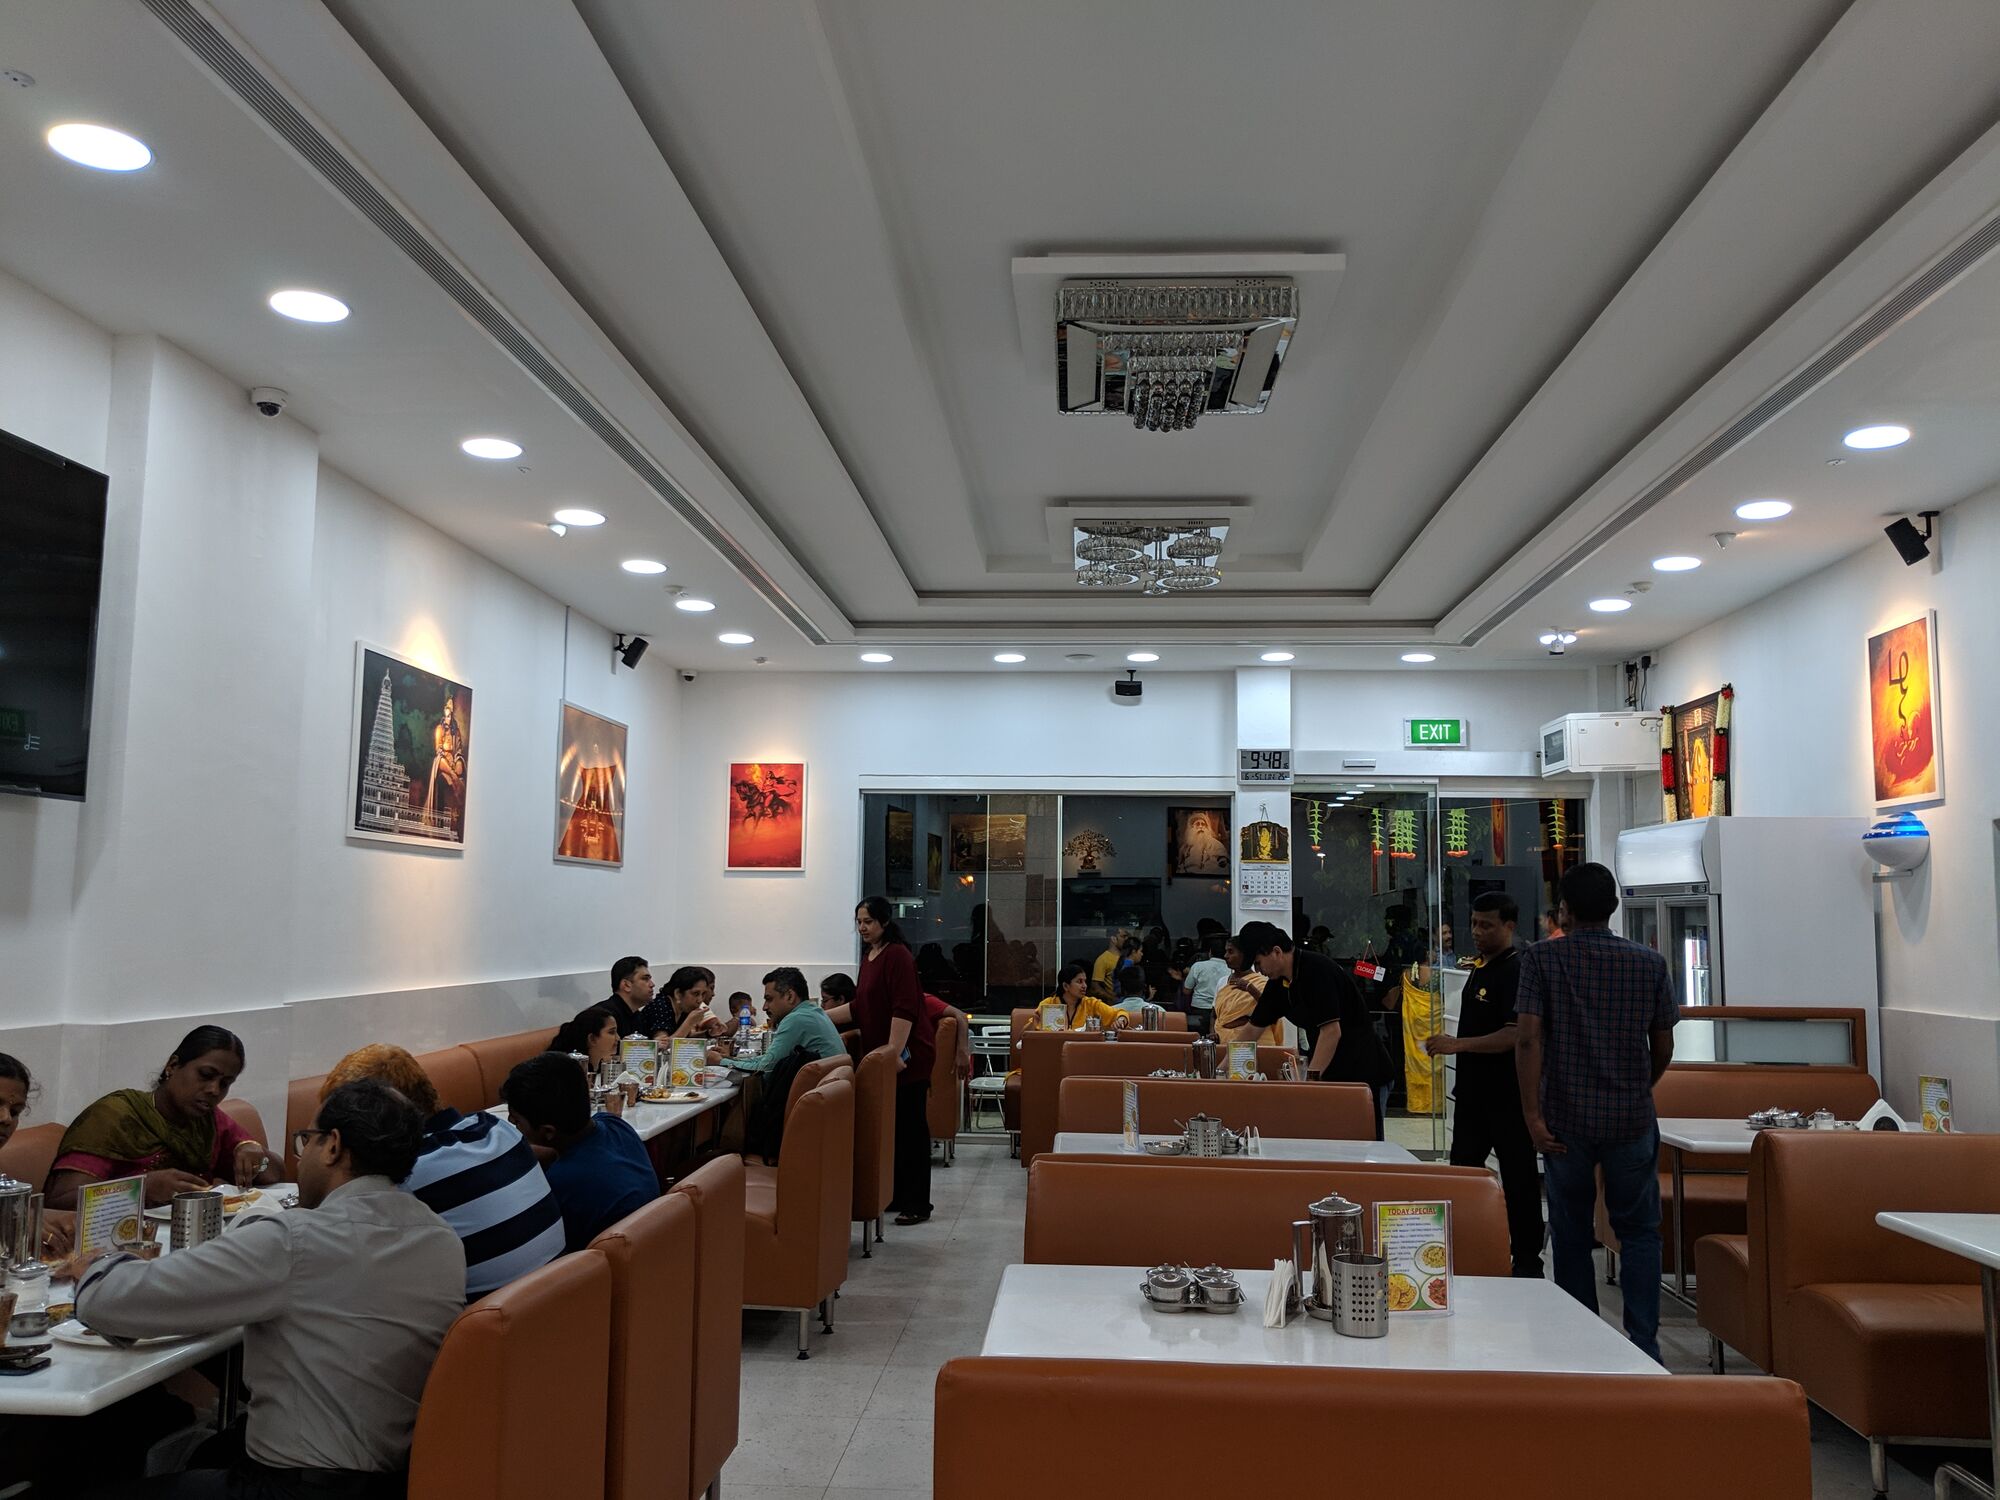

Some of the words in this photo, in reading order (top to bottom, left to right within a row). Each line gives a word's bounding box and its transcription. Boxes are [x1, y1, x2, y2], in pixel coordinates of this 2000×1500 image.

[1419, 724, 1452, 740] EXIT
[1251, 751, 1282, 769] 9:48
[1356, 965, 1375, 975] CLOSED
[1388, 1208, 1409, 1216] TODAY
[1410, 1207, 1437, 1215] SPECIAL
